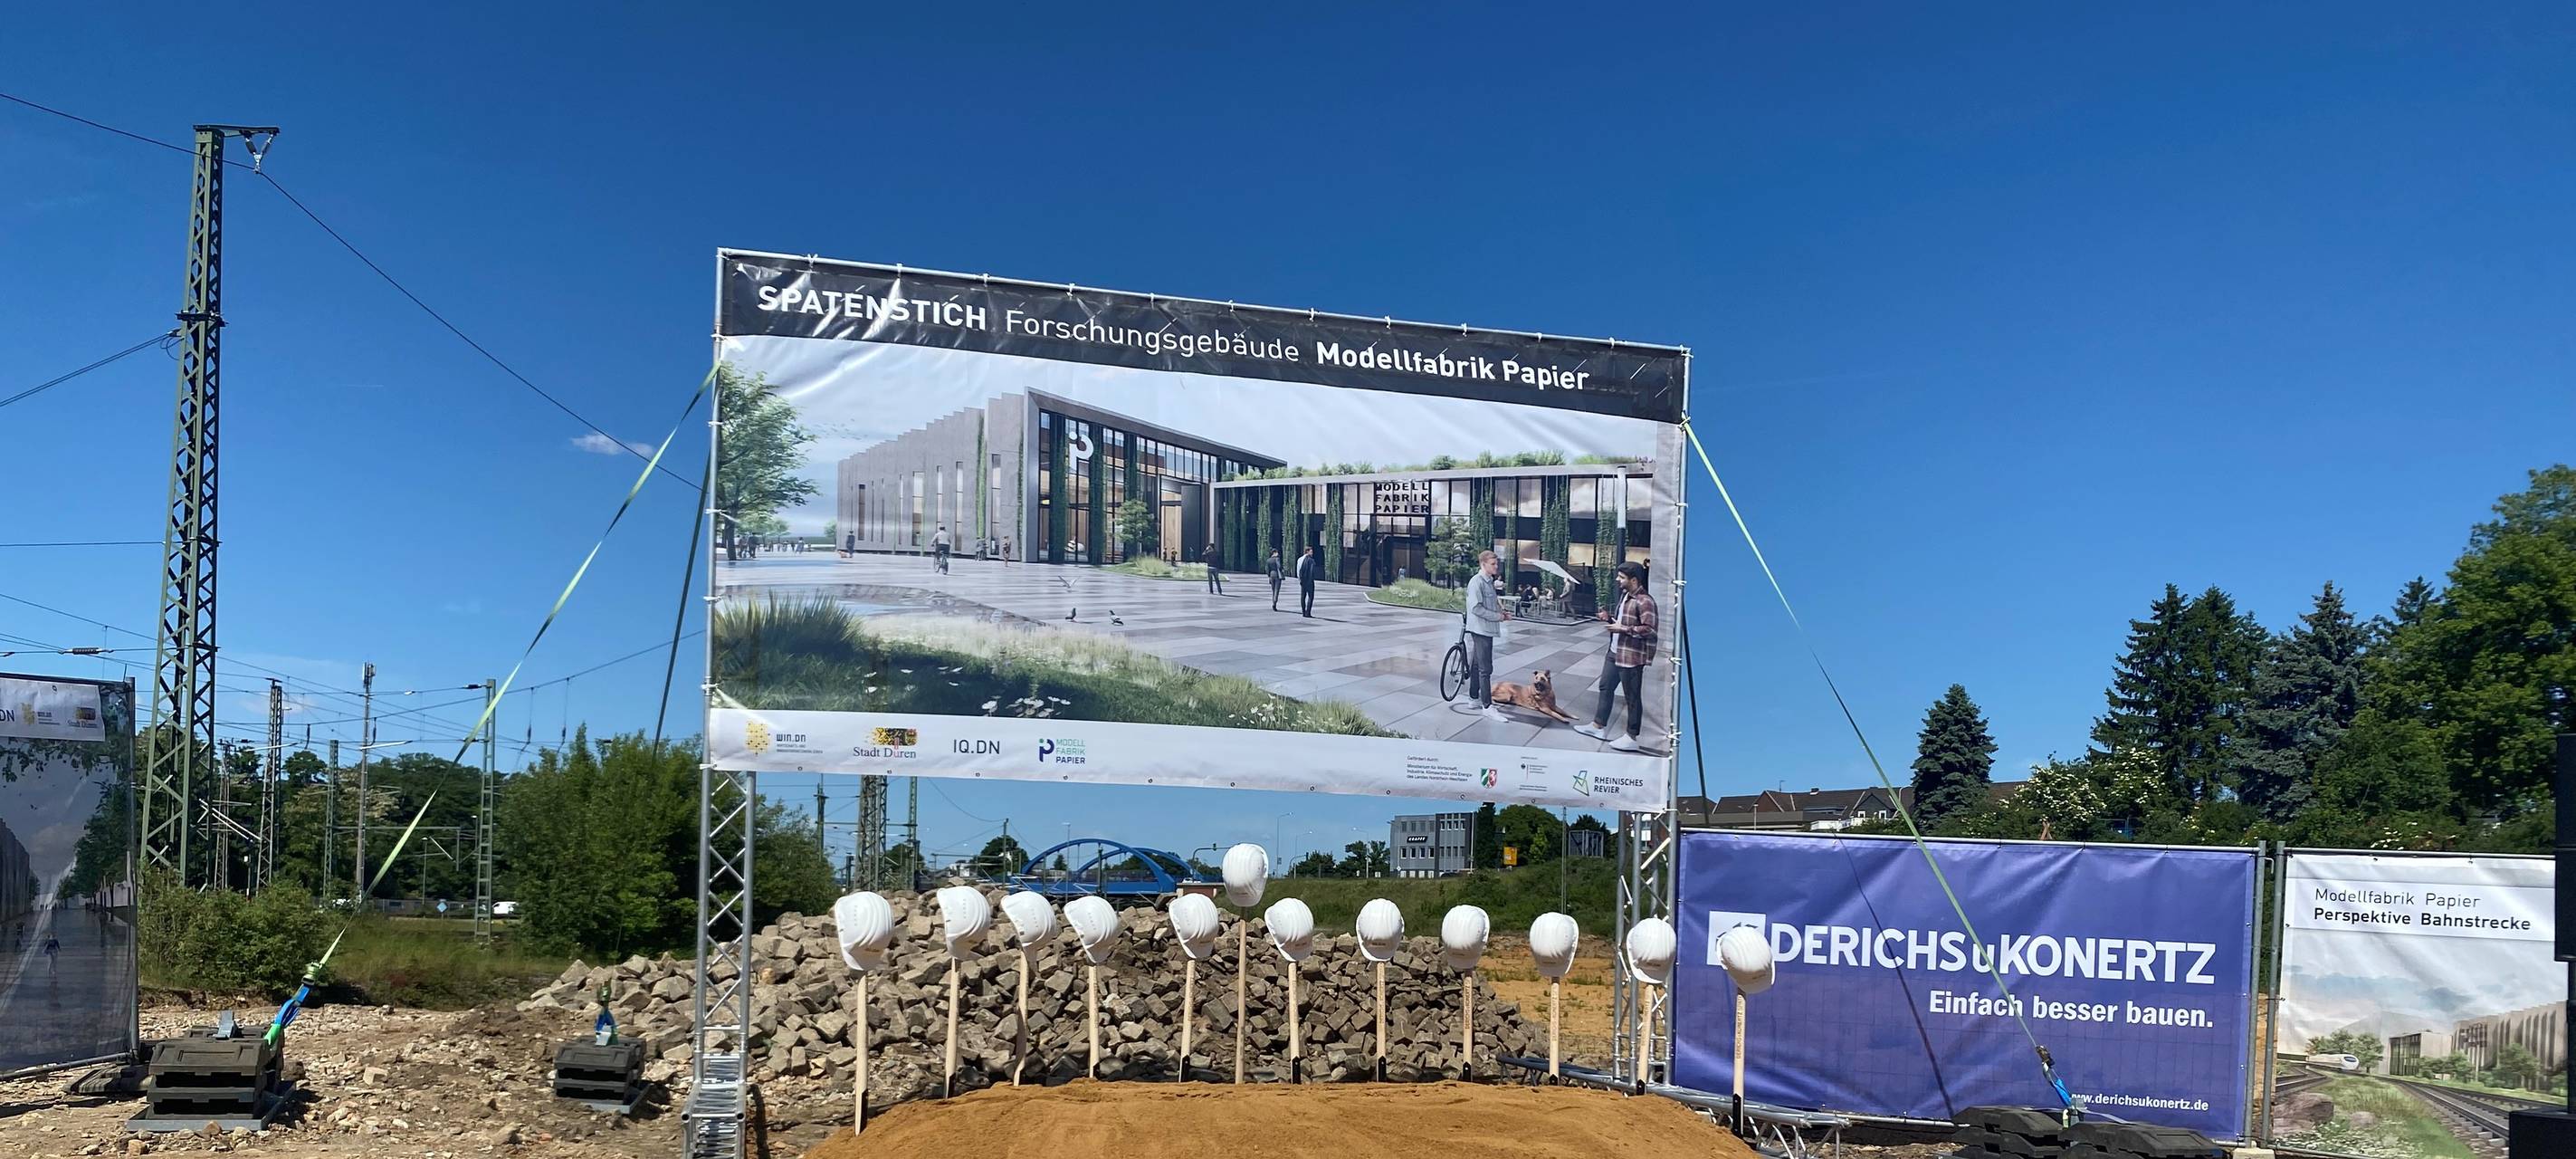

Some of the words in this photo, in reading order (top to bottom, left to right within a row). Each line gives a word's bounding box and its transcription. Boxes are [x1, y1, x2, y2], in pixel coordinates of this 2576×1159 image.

[758, 284, 987, 330] SPATENSTICH
[1007, 310, 1300, 362] Forschungsgebäude
[1317, 340, 1495, 380] Modellfabrik
[1503, 359, 1589, 391] Papier
[1376, 482, 1428, 491] MODELL
[1376, 493, 1429, 502] FABRIK
[1376, 504, 1429, 512] PAPIER
[953, 739, 1000, 754] IQ.DN
[1055, 738, 1085, 747] MODELL
[853, 746, 881, 757] Stadt
[1055, 747, 1085, 755] FABRIK
[1055, 756, 1085, 764] PAPIER
[1594, 776, 1644, 787] RHEINISCHES
[1593, 785, 1620, 794] REVIER
[2314, 888, 2414, 905] Modellfabrik
[2426, 893, 2481, 908] Papier
[2314, 907, 2411, 925] Perspektive
[2421, 913, 2532, 931] Bahnstrecke
[1930, 990, 2023, 1018] Einfach
[2034, 1000, 2119, 1023] besser
[2126, 1004, 2214, 1029] bauen.
[2071, 1093, 2209, 1111] w.derichsukonertz.de
